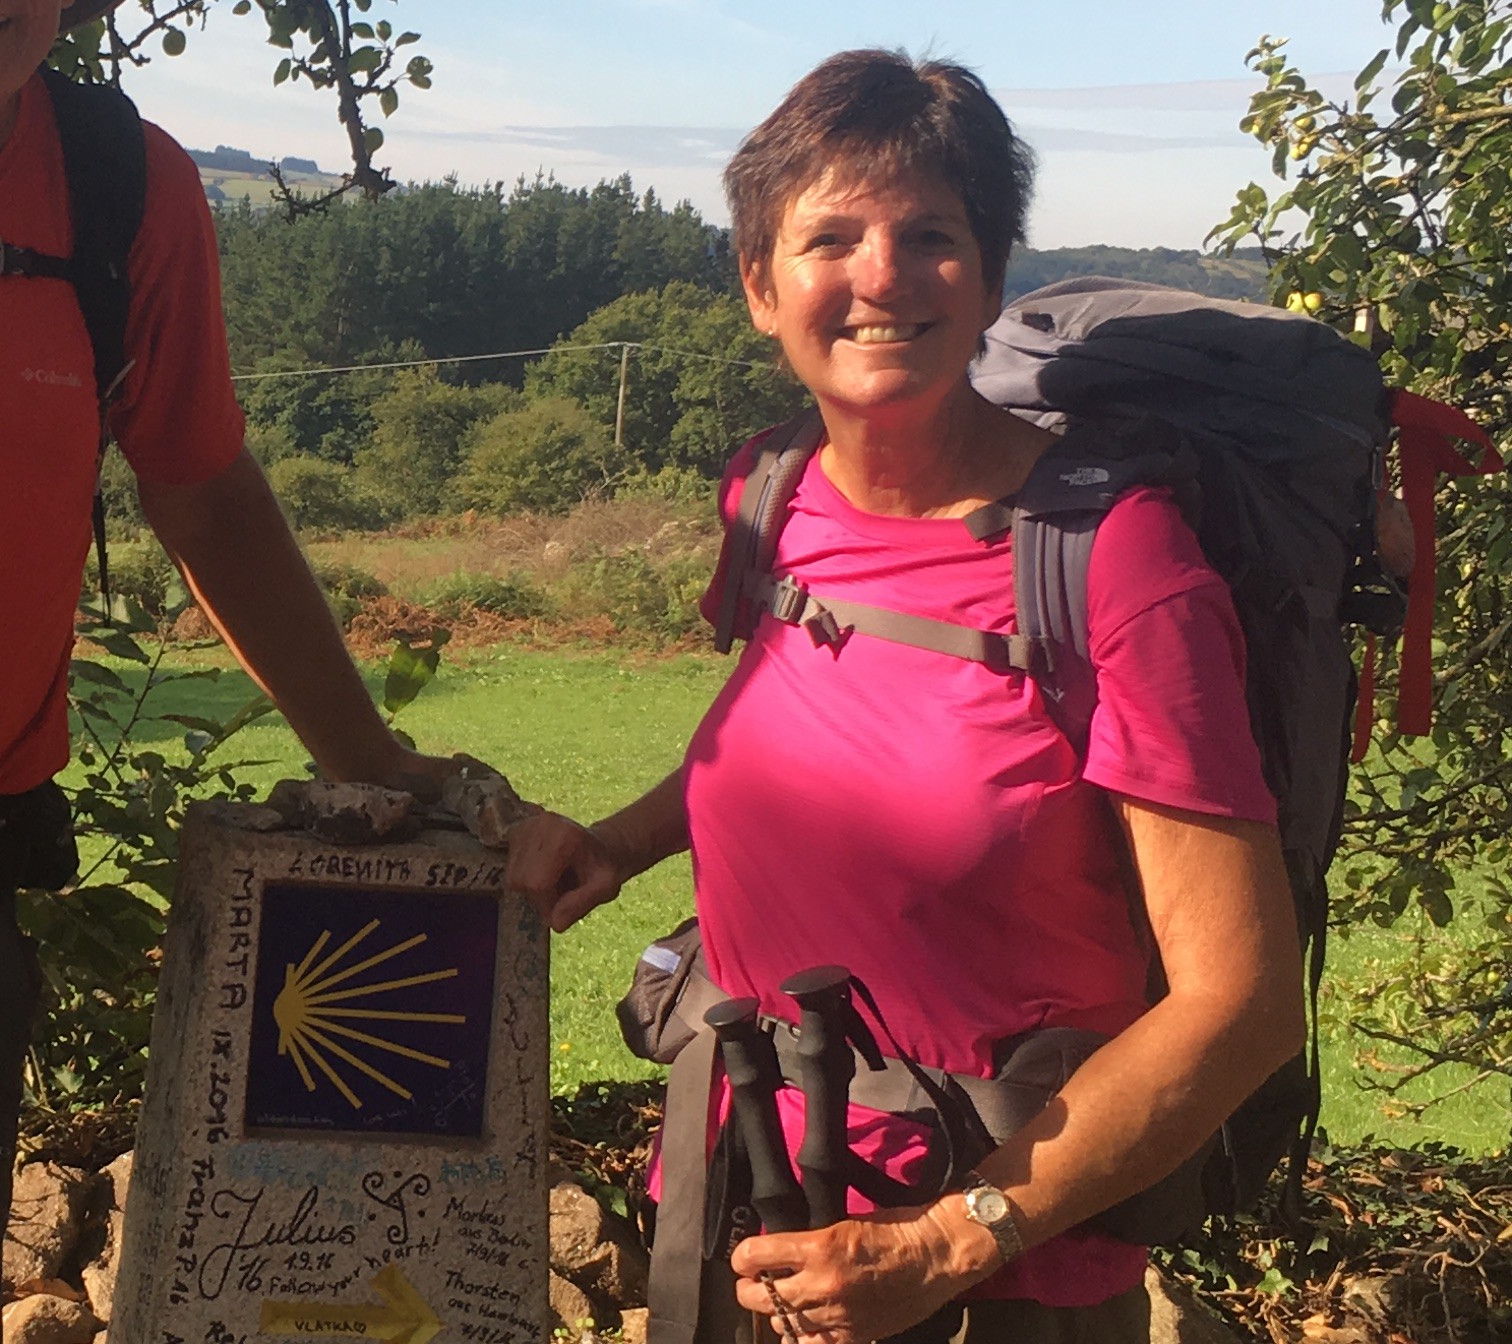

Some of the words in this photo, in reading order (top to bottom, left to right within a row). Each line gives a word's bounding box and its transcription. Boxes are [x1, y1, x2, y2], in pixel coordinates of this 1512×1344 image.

[219, 866, 256, 1010] MARTA
[198, 1185, 356, 1300] Julius
[444, 1267, 522, 1305] Thorsten
